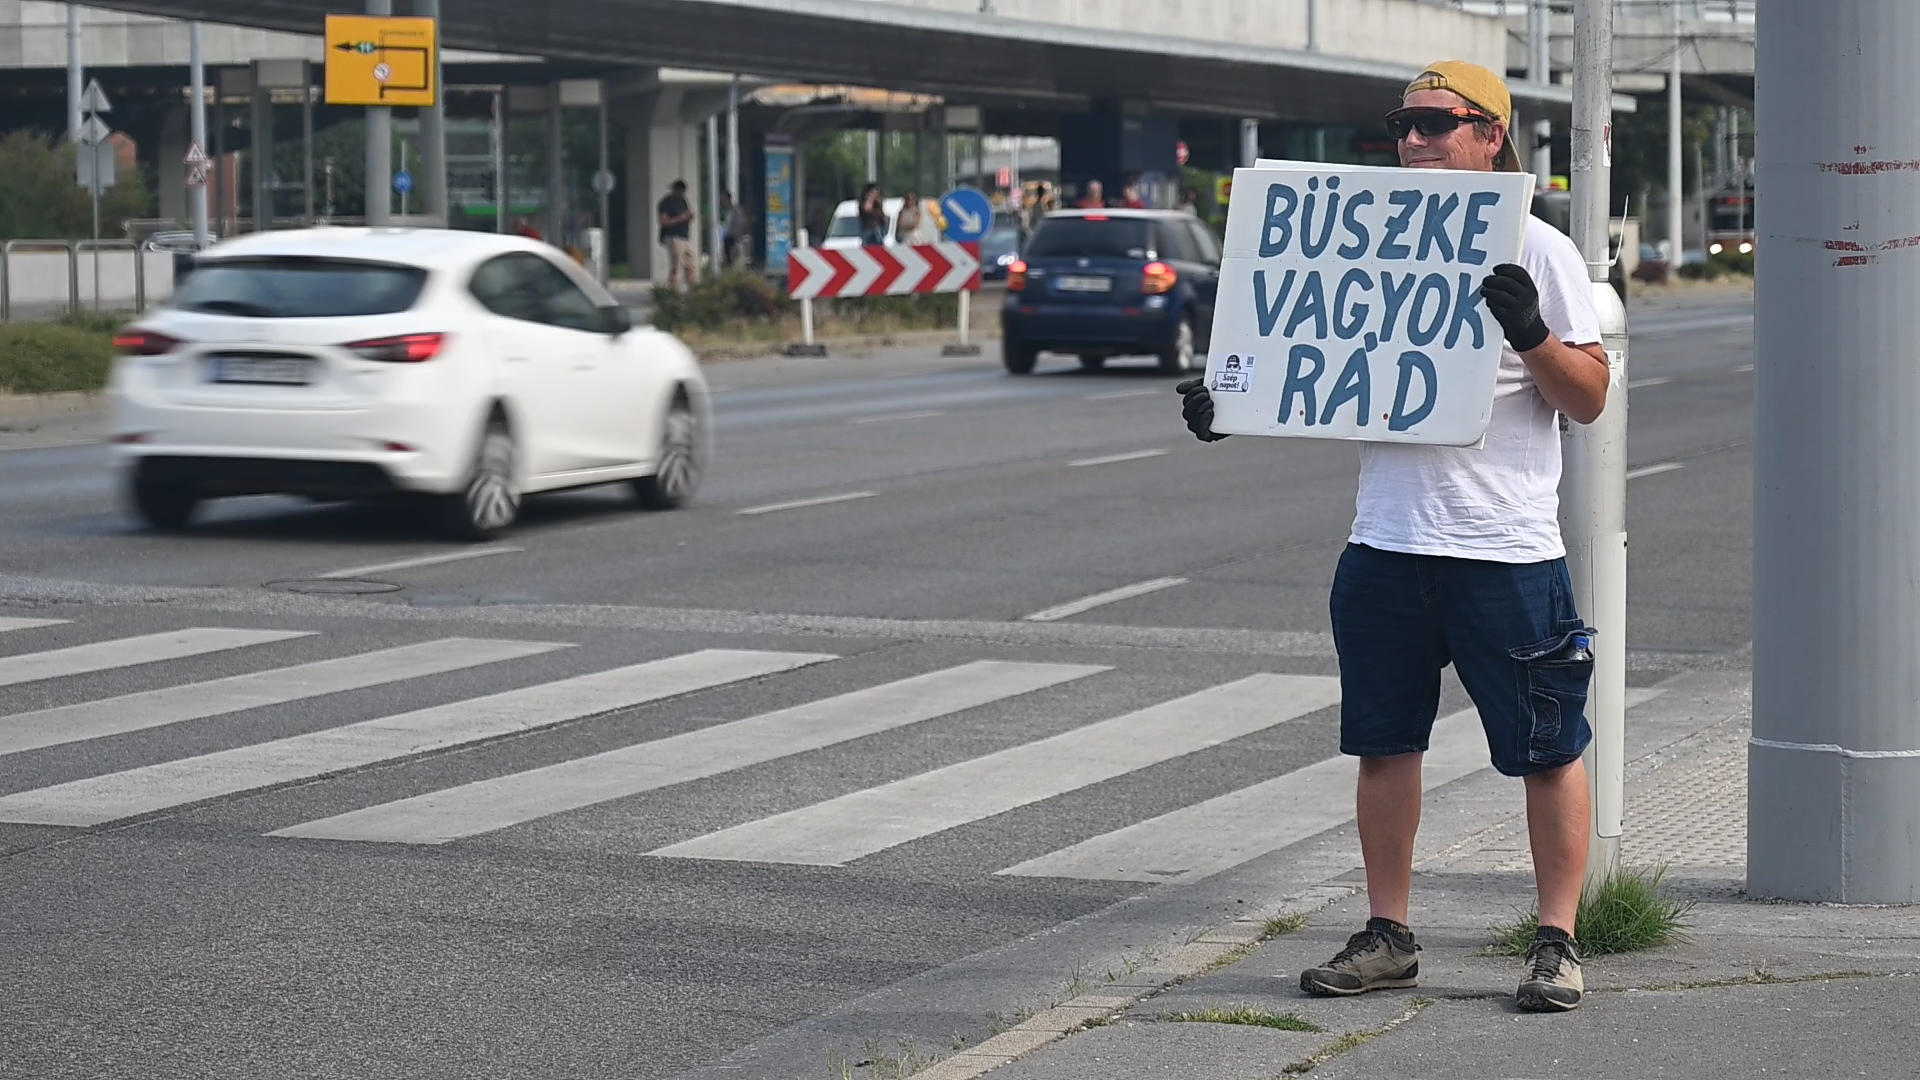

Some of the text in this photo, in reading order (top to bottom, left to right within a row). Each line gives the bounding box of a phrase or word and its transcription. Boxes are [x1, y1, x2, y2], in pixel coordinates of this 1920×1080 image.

[1258, 176, 1501, 265] BÜSZKE
[1253, 268, 1485, 350] VAGYOK
[1219, 381, 1240, 390] napot!
[1222, 373, 1238, 383] Szép
[1277, 331, 1438, 431] RÁD
